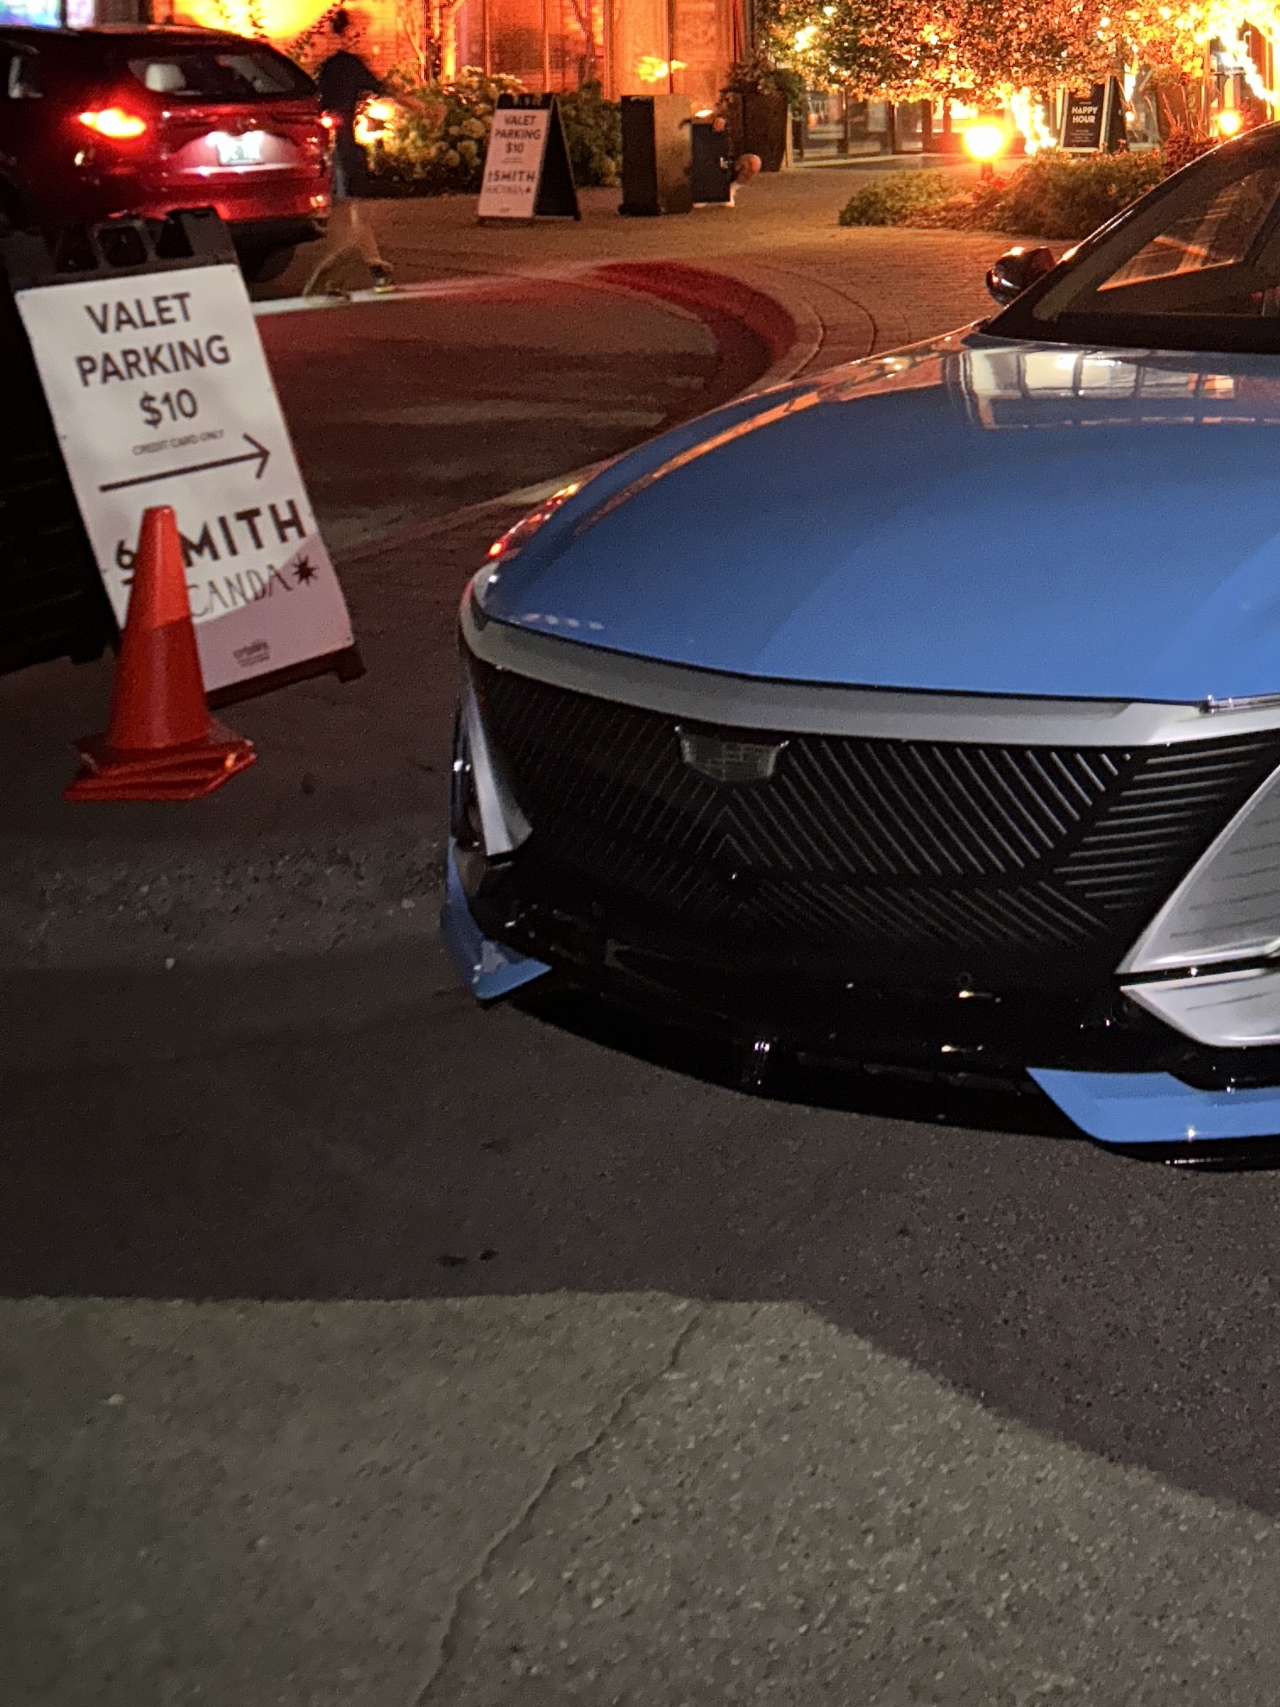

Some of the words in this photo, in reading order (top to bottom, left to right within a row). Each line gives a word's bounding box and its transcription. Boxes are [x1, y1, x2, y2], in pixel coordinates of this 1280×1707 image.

[1071, 106, 1099, 114] HAPPY
[504, 115, 536, 126] VALET
[1072, 115, 1096, 124] HOUR
[495, 129, 541, 140] PARKING
[506, 142, 524, 154] $10
[85, 293, 192, 335] VALET
[75, 334, 232, 387] PARKING
[140, 388, 199, 429] $10
